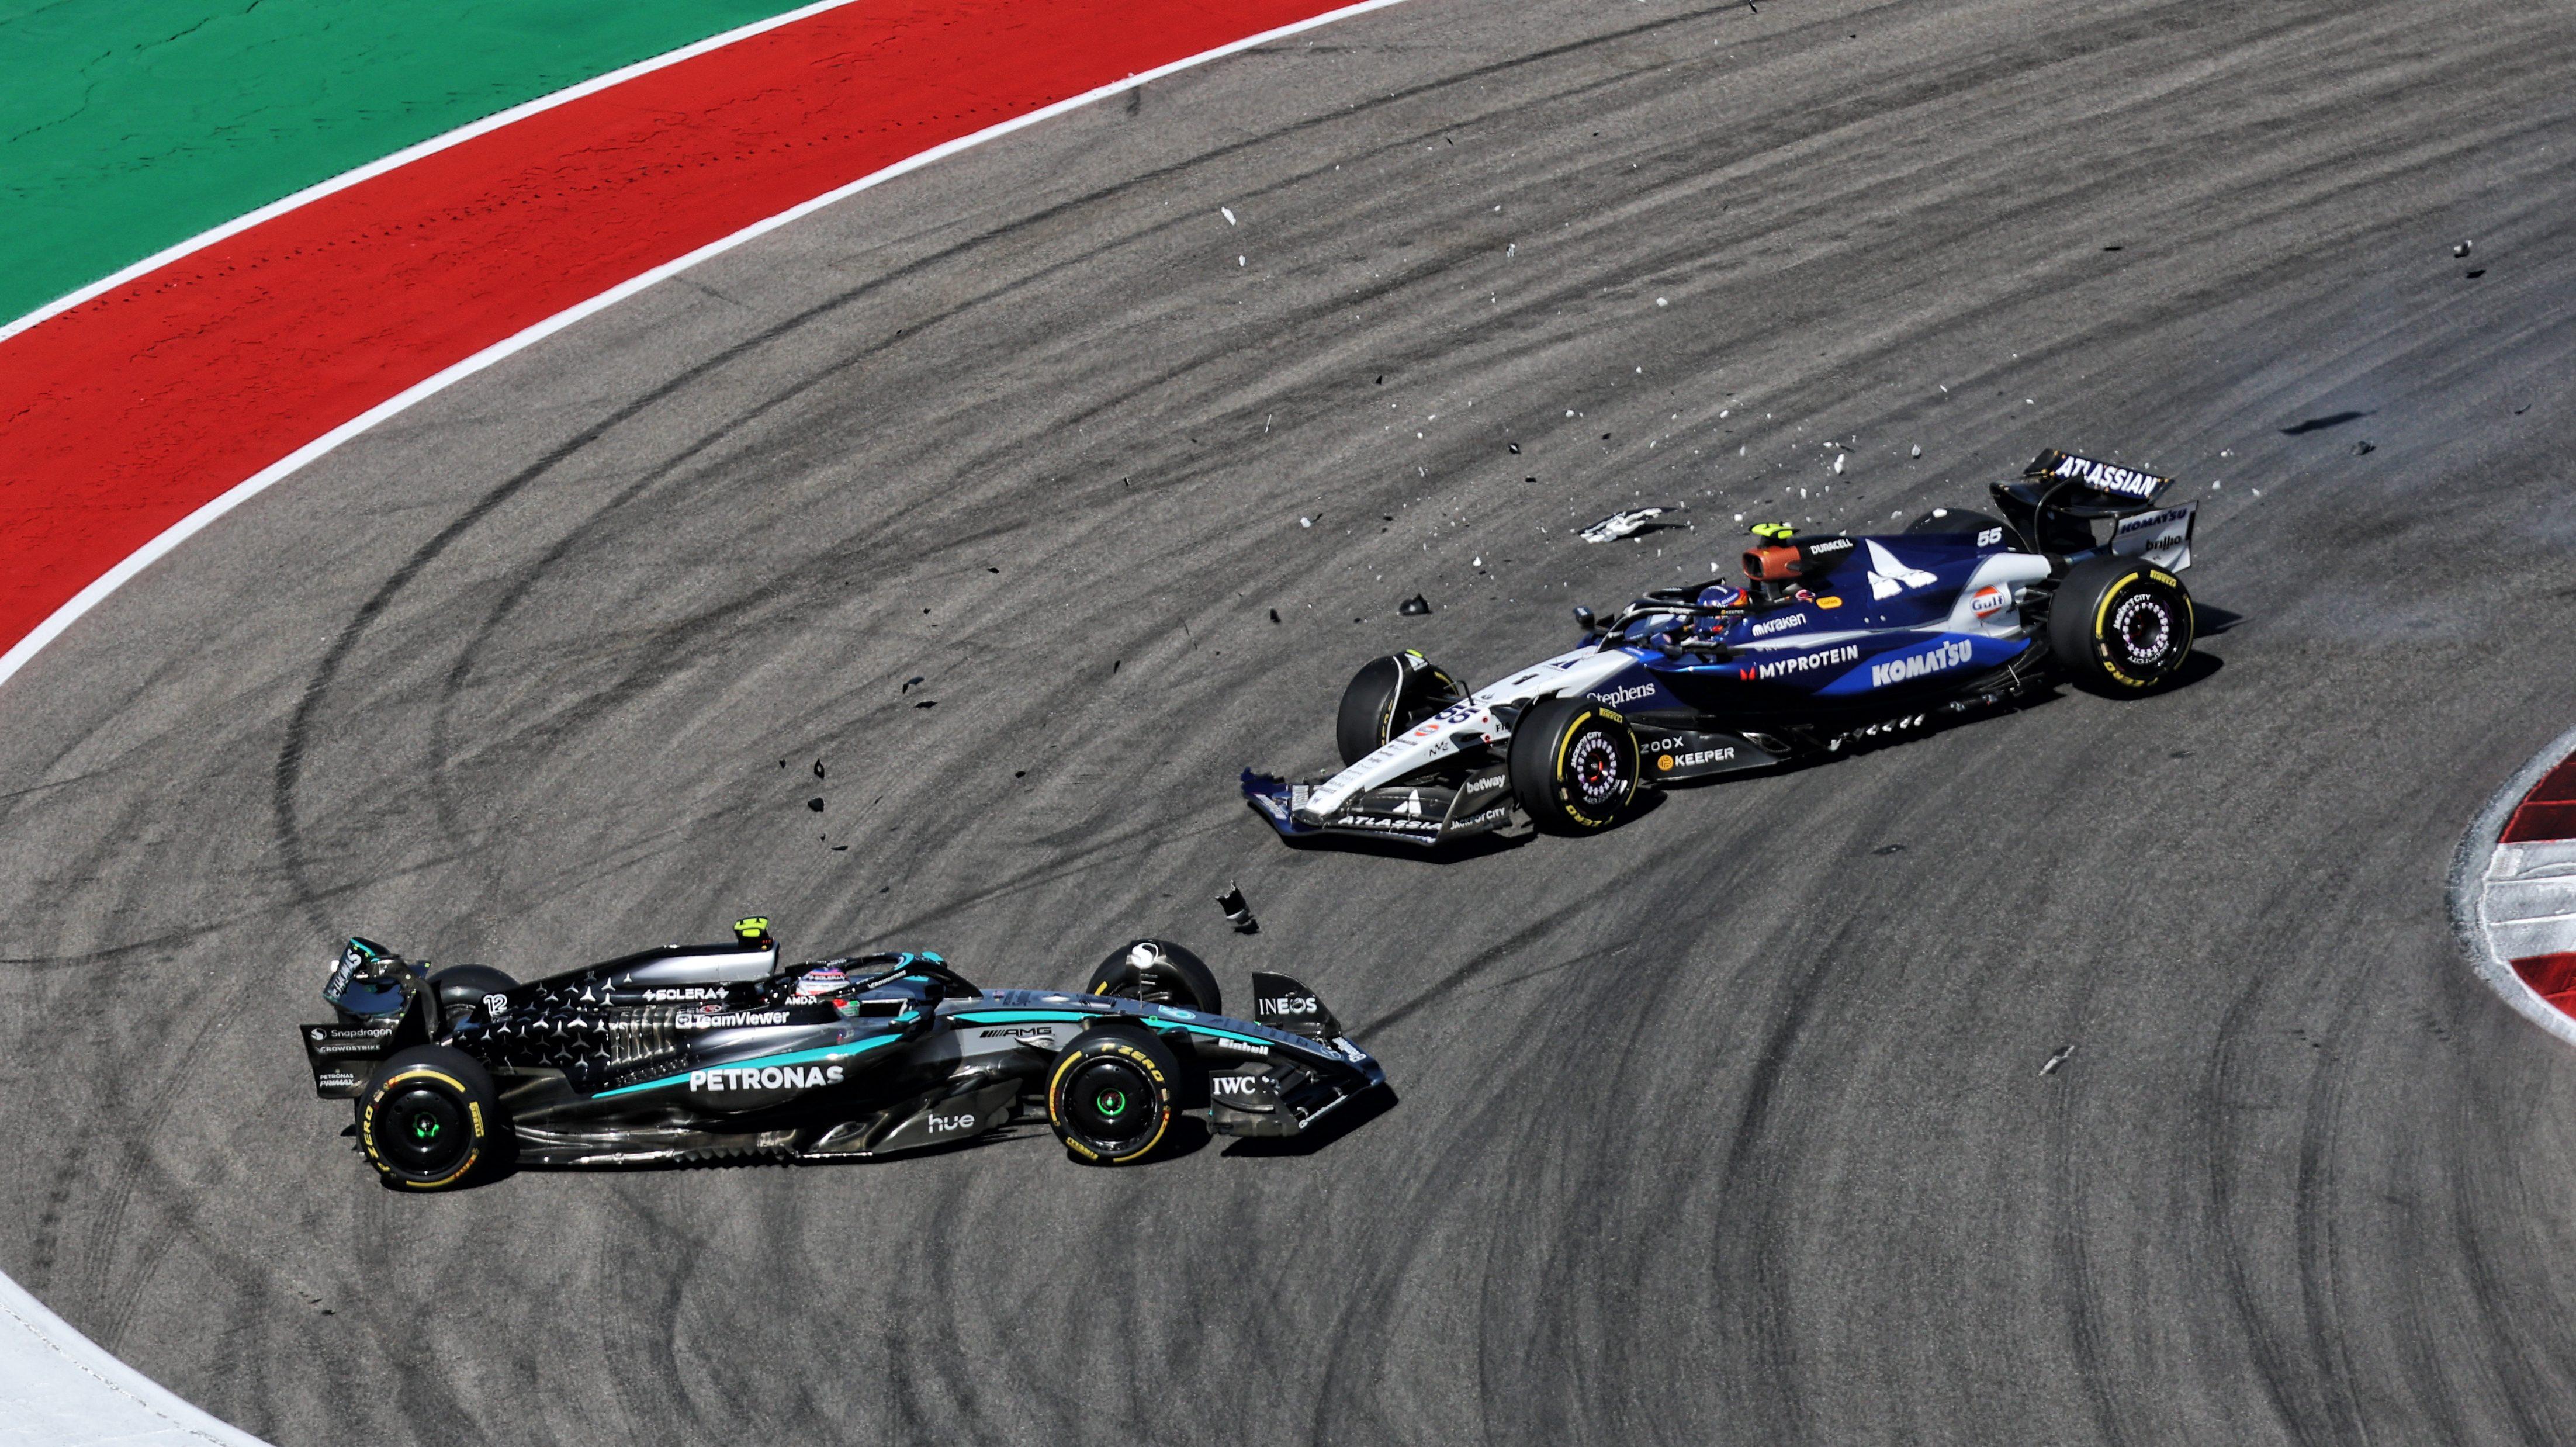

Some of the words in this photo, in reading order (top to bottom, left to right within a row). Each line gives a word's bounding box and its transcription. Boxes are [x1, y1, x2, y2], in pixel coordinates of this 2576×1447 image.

[2055, 456, 2159, 496] ATLASSIAN
[2120, 507, 2187, 534] KOMATSU
[1810, 538, 1853, 555] DURACELL
[1976, 527, 2002, 548] 55
[1972, 596, 2003, 611] Gulf
[1759, 644, 1859, 679] MYPROTEIN
[1872, 639, 1972, 687] KOMATSU
[1599, 707, 1623, 724] PIRELLI
[1587, 731, 1602, 740] CITY
[1675, 747, 1735, 767] KEEPER
[1466, 774, 1505, 794] betway
[1486, 807, 1505, 820] CITY
[1338, 816, 1442, 830] ATLASSIA
[656, 987, 718, 1001] SOLERA
[785, 995, 809, 1006] AMD
[483, 994, 508, 1017] 12
[1259, 997, 1317, 1015] INEOS
[693, 1011, 790, 1029] TeamViewer
[331, 1027, 392, 1038] Snapdragon
[1003, 1027, 1052, 1037] AMG
[320, 1044, 380, 1053] CROWDSTRIKE
[1118, 1045, 1165, 1082] ZERO
[690, 1065, 844, 1092] PETRONAS
[1213, 1076, 1255, 1095] IWC
[363, 1104, 379, 1159] ZERO
[929, 1114, 975, 1133] hue
